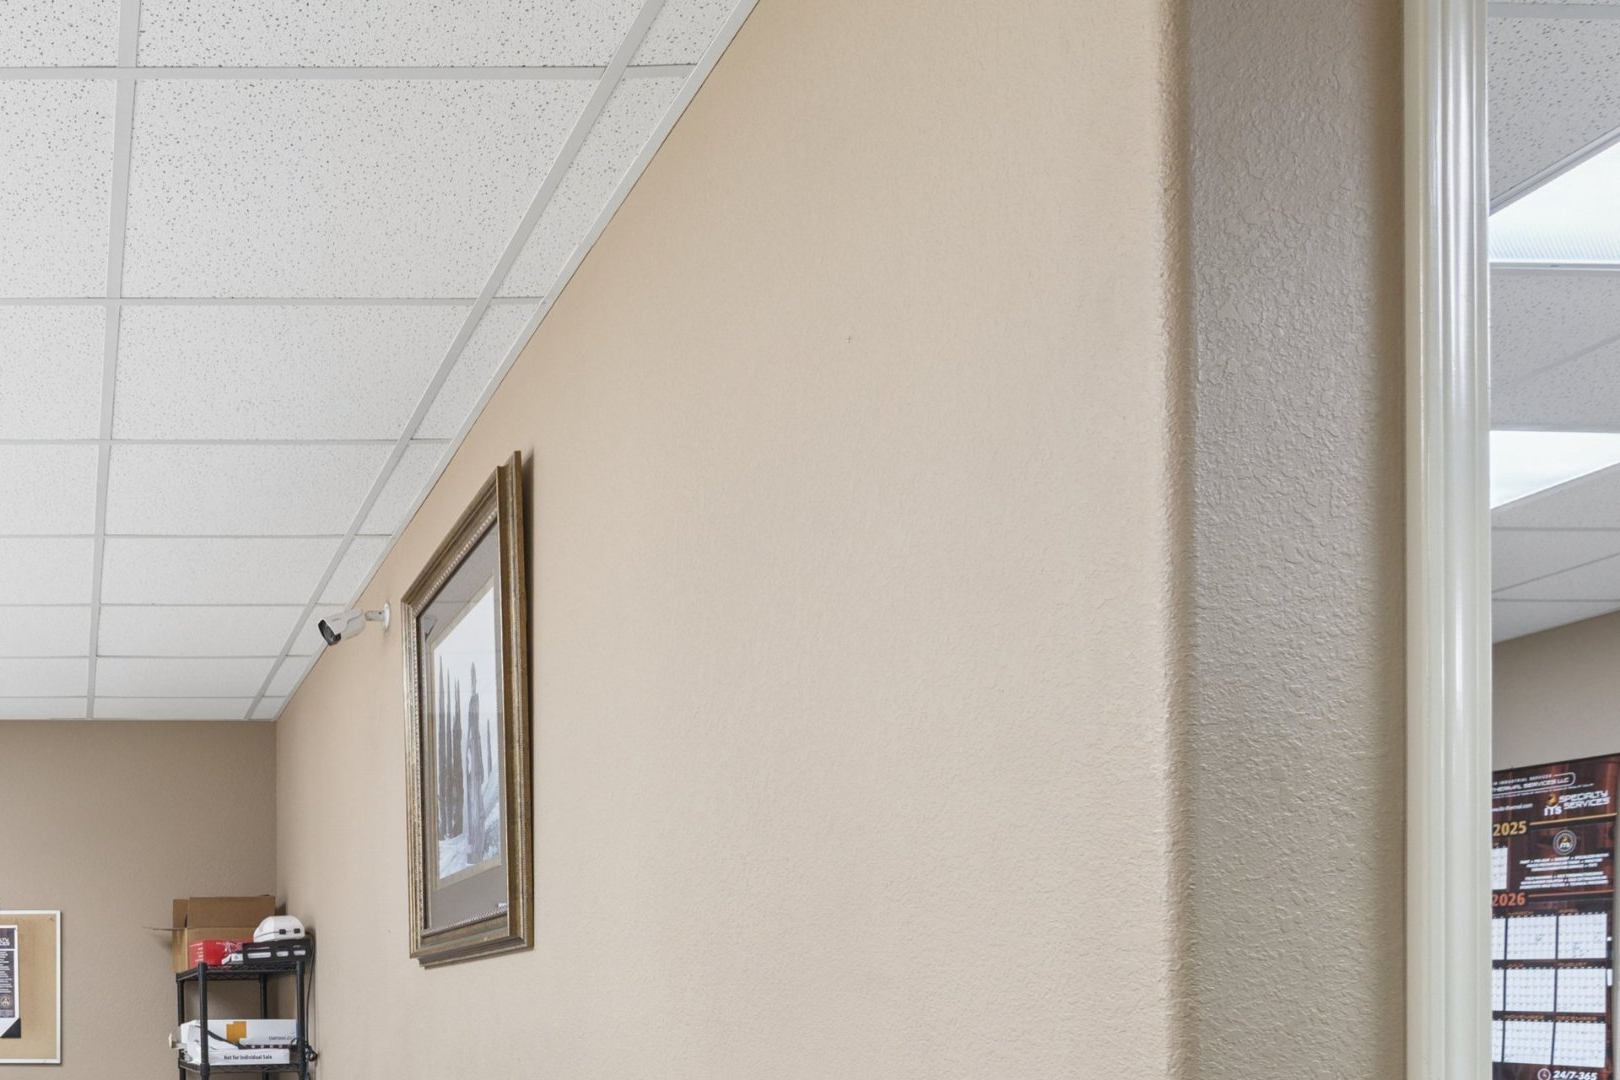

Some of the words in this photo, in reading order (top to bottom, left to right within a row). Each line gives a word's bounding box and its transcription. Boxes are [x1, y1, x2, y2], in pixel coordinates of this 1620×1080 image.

[1493, 821, 1527, 837] 2025
[1492, 893, 1526, 906] 2026
[1553, 1070, 1598, 1080] 24/7-365
